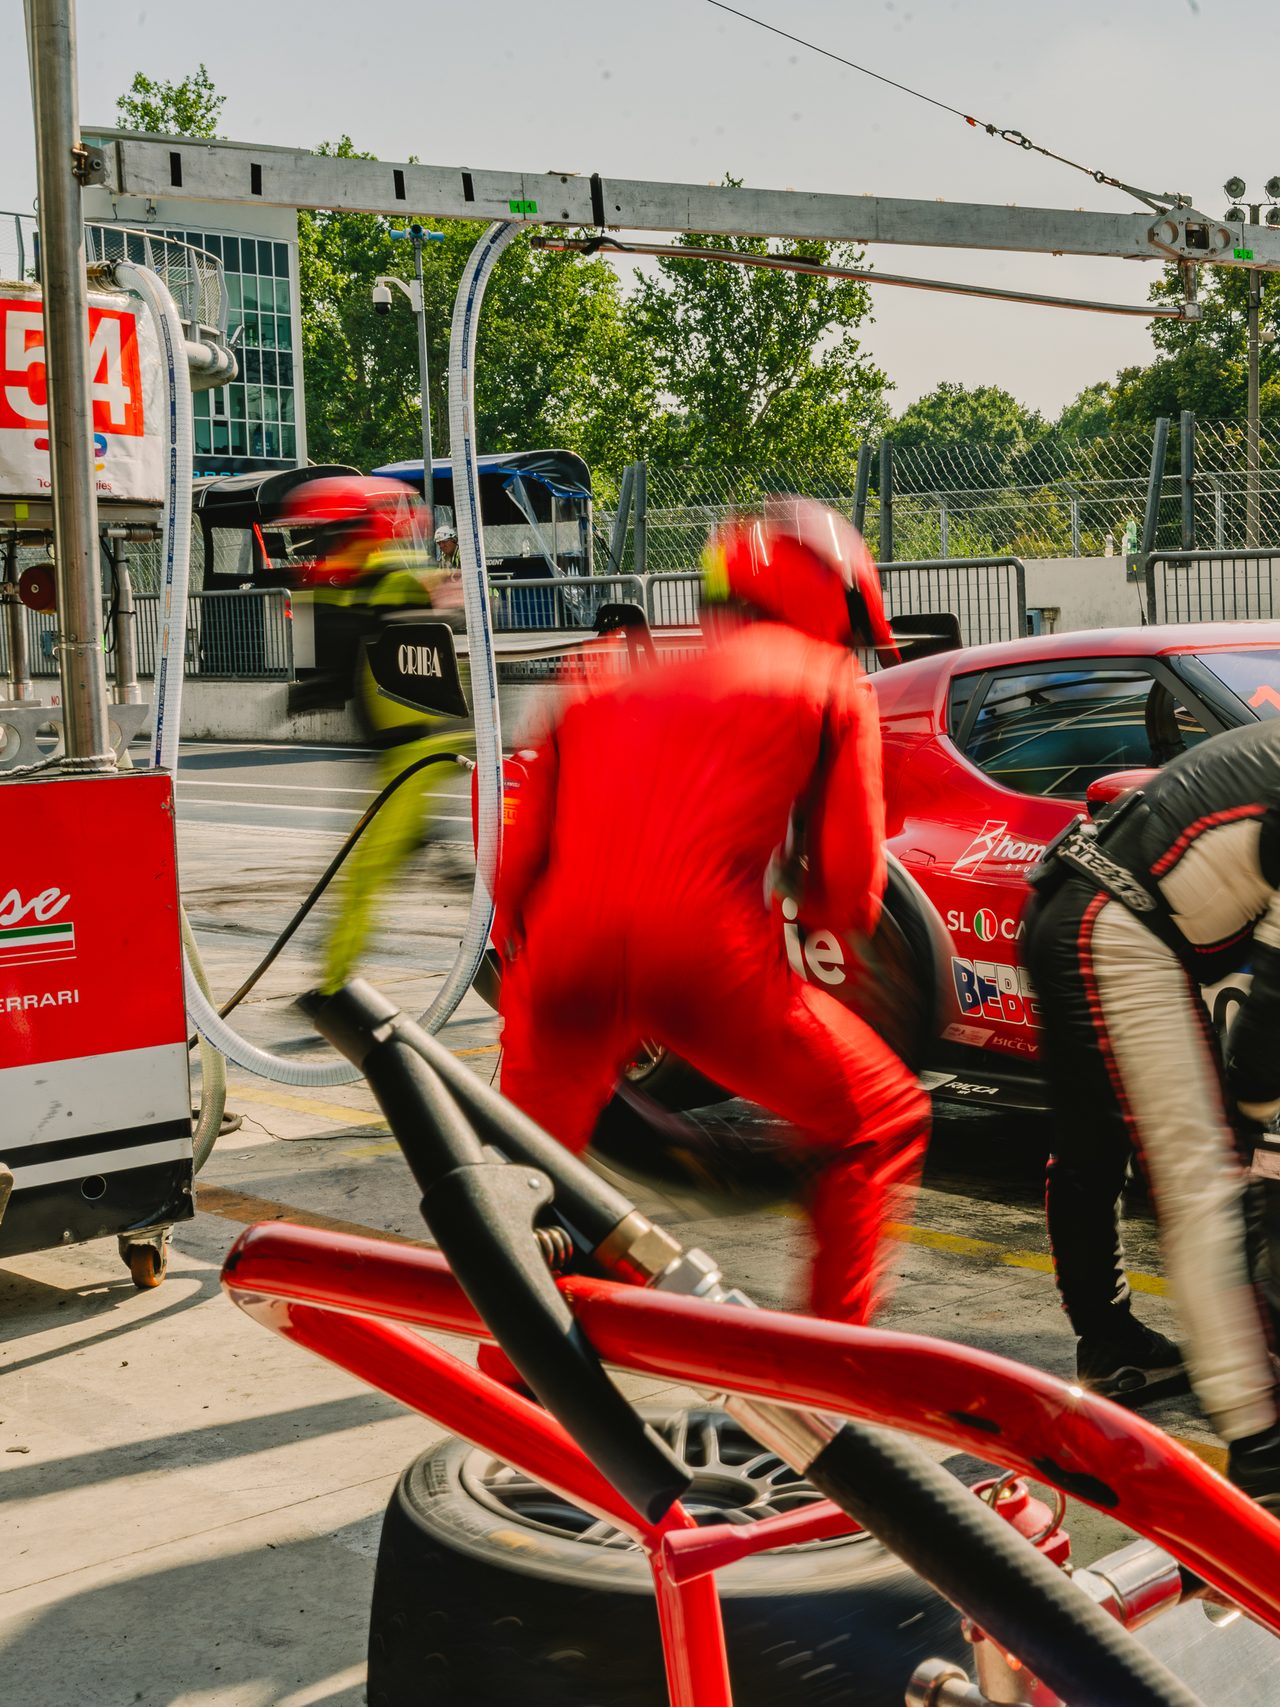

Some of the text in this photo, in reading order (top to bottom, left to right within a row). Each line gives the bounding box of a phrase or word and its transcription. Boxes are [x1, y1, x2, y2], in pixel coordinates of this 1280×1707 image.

[4, 310, 131, 425] 54
[398, 644, 443, 678] CRIBA
[993, 835, 1048, 863] hom
[0, 989, 80, 1013] RRARI
[945, 1081, 1000, 1095] RICCA
